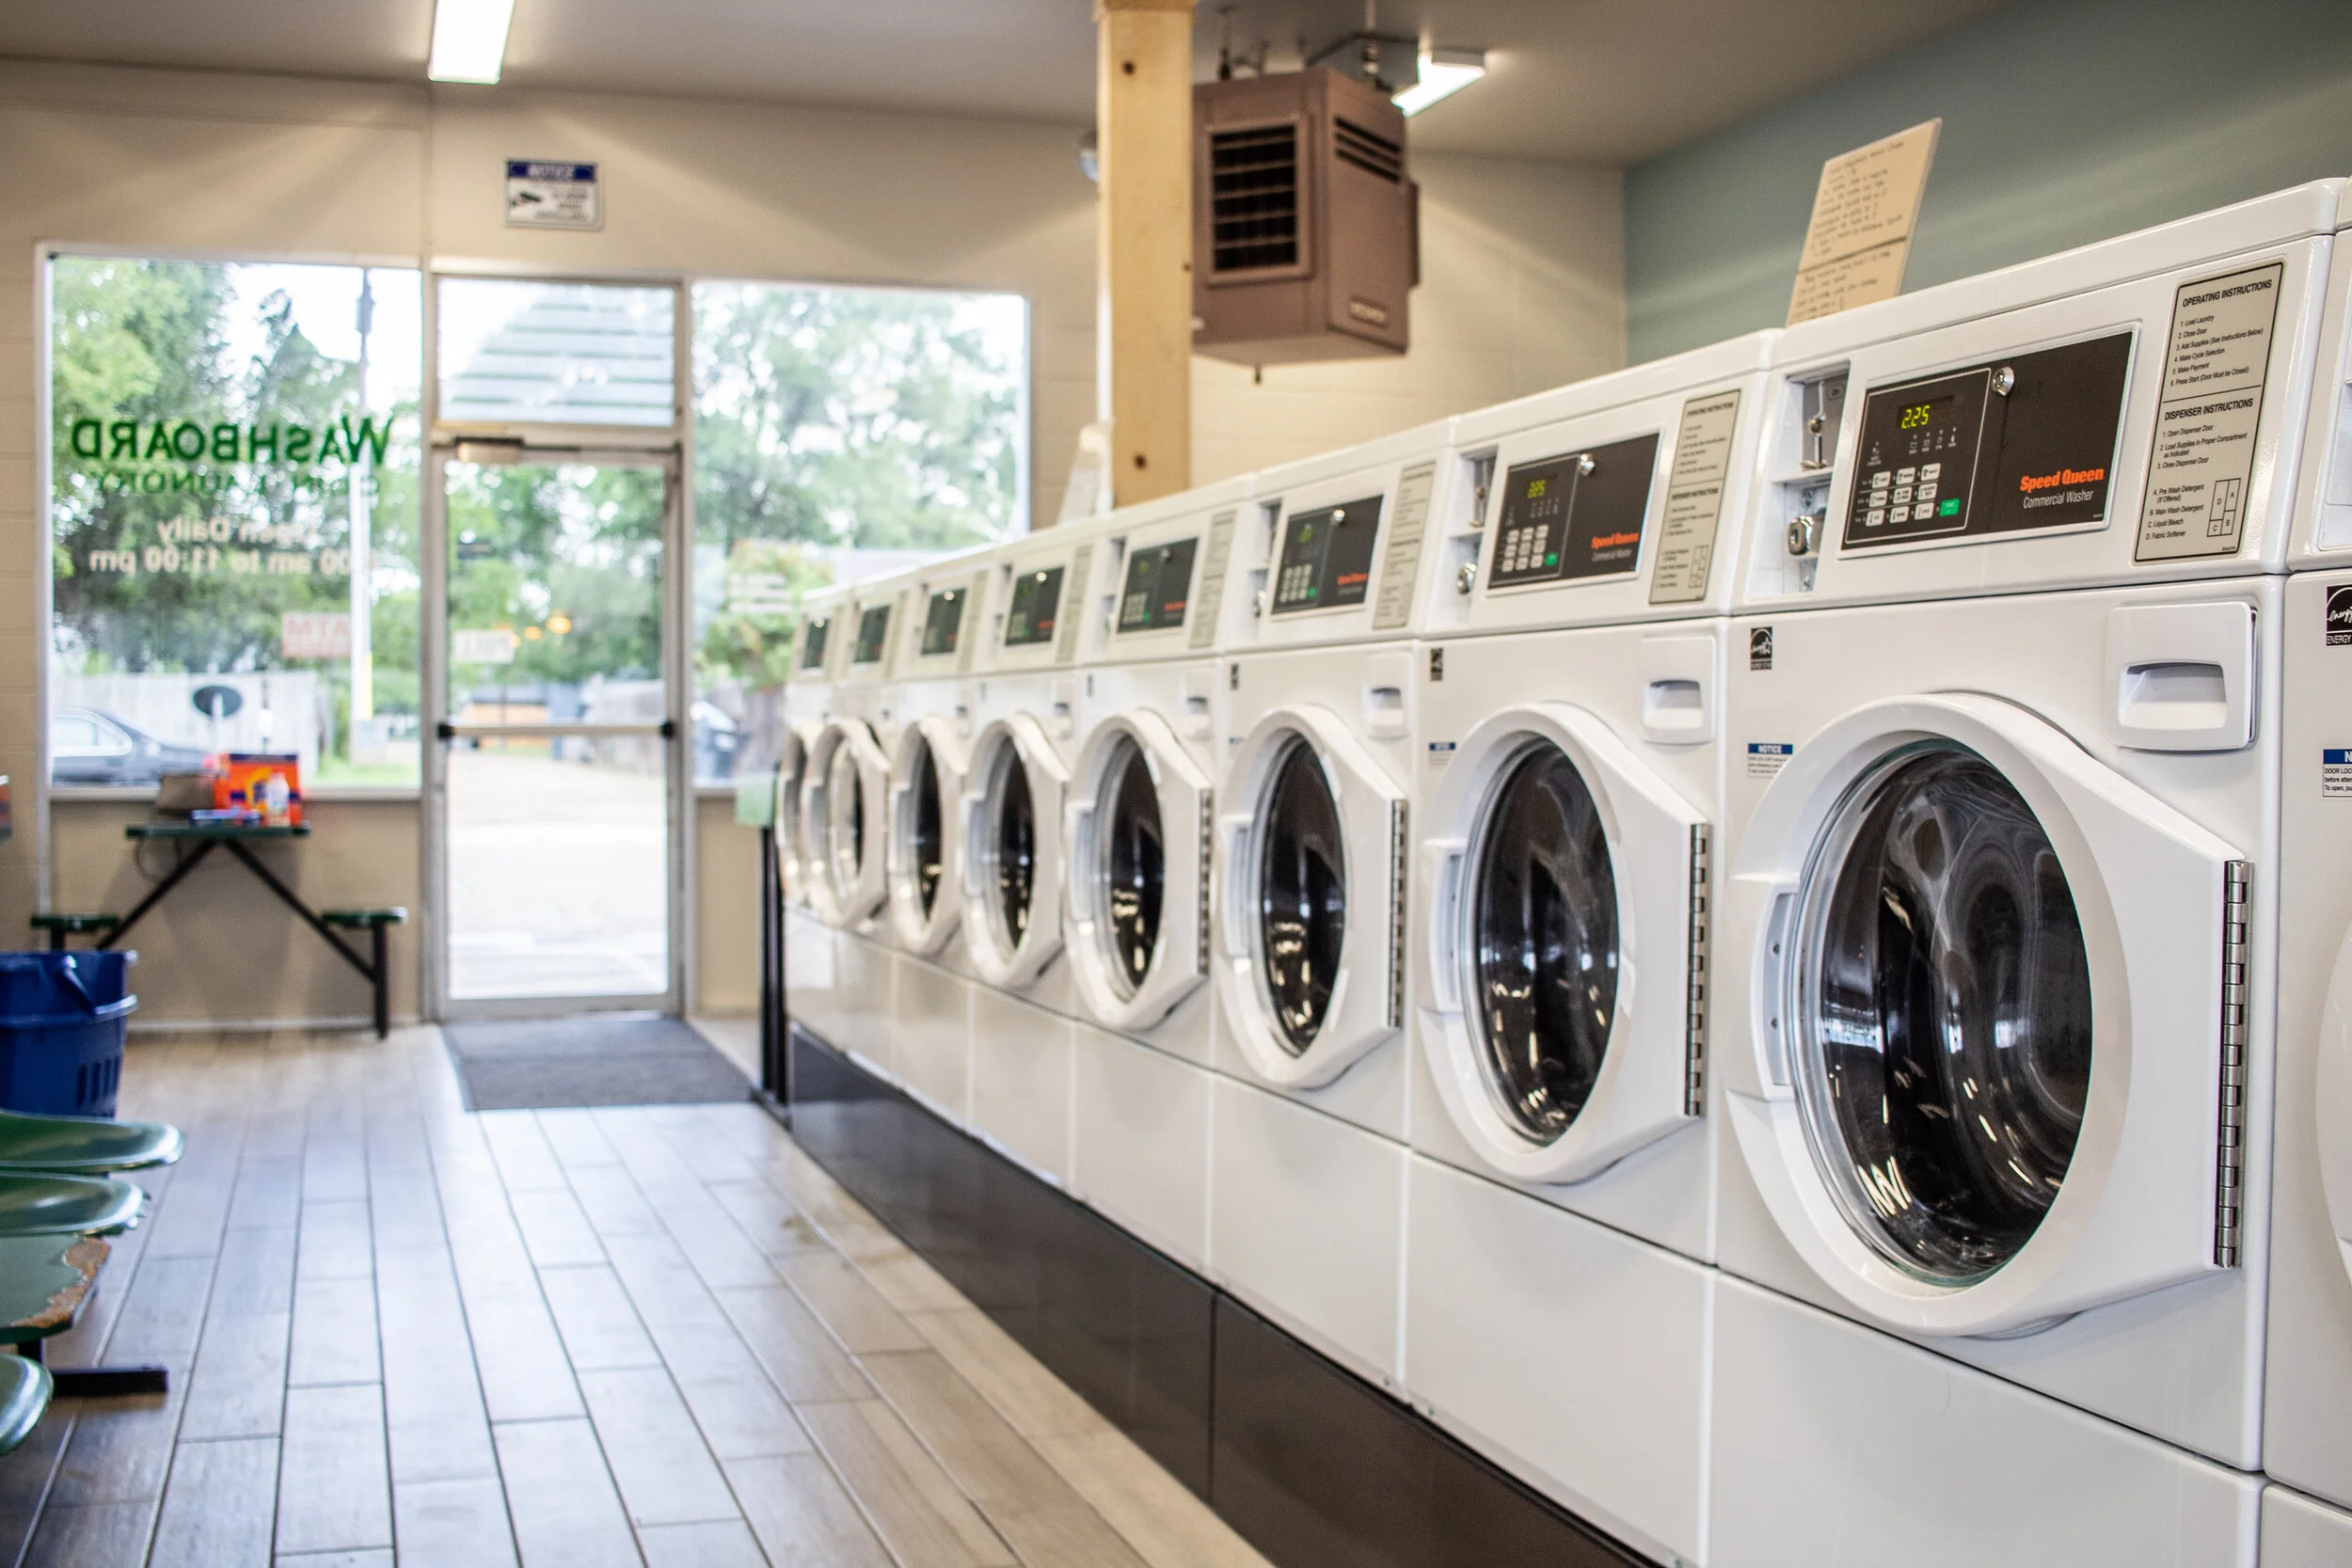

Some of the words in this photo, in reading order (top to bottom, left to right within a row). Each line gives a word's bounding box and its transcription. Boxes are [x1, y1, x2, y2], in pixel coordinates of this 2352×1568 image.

[2183, 291, 2220, 308] OPERATING
[2221, 279, 2272, 299] INSTRUCTIONS
[2185, 318, 2197, 326] Load
[2197, 314, 2215, 325] Laundry
[2181, 341, 2190, 350] Add
[2190, 339, 2210, 349] Supplies
[2210, 337, 2220, 346] (See
[2221, 332, 2247, 342] Instructions
[2247, 327, 2264, 338] Below)
[2183, 330, 2196, 339] Close
[2179, 354, 2191, 362] Make
[2192, 351, 2204, 360] Cycle
[2205, 347, 2225, 357] Selection
[2177, 366, 2189, 374] Make
[2189, 362, 2210, 373] Payment
[2188, 375, 2200, 384] Start
[2200, 373, 2213, 383] (Door
[2213, 371, 2224, 379] Must
[2231, 366, 2249, 375] Closed)
[2164, 406, 2202, 421] DISPENSER
[2202, 398, 2254, 415] INSTRUCTIONS
[2167, 429, 2179, 438] Open
[2180, 426, 2201, 436] Dispenser
[2202, 424, 2214, 433] Door
[2165, 442, 2176, 451] Load
[2176, 439, 2196, 450] Supplies
[2201, 437, 2217, 447] Proper
[2217, 433, 2248, 444] Compartment
[2169, 450, 2190, 458] Indicated
[2162, 461, 2174, 469] Close
[2175, 458, 2197, 468] Dispenser
[2020, 470, 2061, 494] Speed
[2061, 467, 2105, 485] Queen
[2182, 483, 2204, 493] Detergent
[2023, 492, 2065, 509] Commercial
[2066, 489, 2094, 503] Washer
[2163, 495, 2182, 503] Offered)
[2181, 504, 2204, 514] Detergent
[2153, 519, 2168, 529] Liquid
[2168, 518, 2184, 527] Bleach
[2152, 531, 2166, 540] Fabric
[2327, 634, 2352, 644] ENERGY
[1758, 744, 1782, 754] NOTICE
